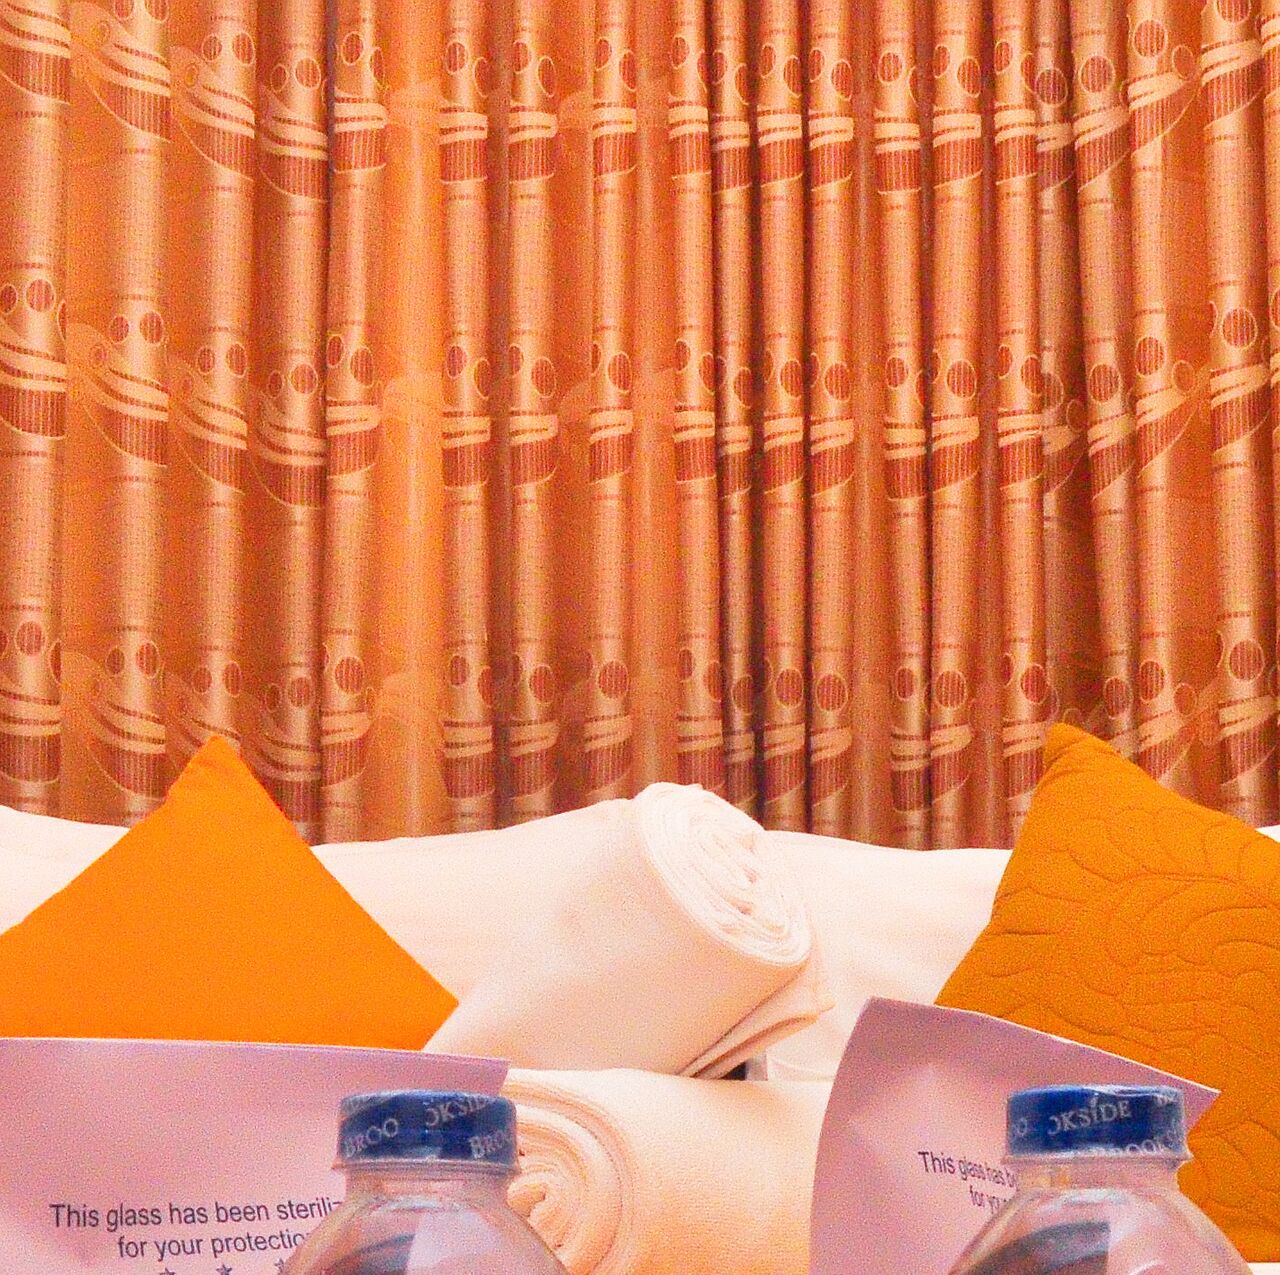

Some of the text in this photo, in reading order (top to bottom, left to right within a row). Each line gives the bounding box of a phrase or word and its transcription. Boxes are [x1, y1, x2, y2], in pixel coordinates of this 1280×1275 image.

[918, 1151, 956, 1174] This
[50, 1204, 99, 1228] This
[106, 1203, 162, 1232] glass
[169, 1203, 208, 1225] has
[216, 1201, 270, 1223] been
[118, 1229, 309, 1262] for your protectio
